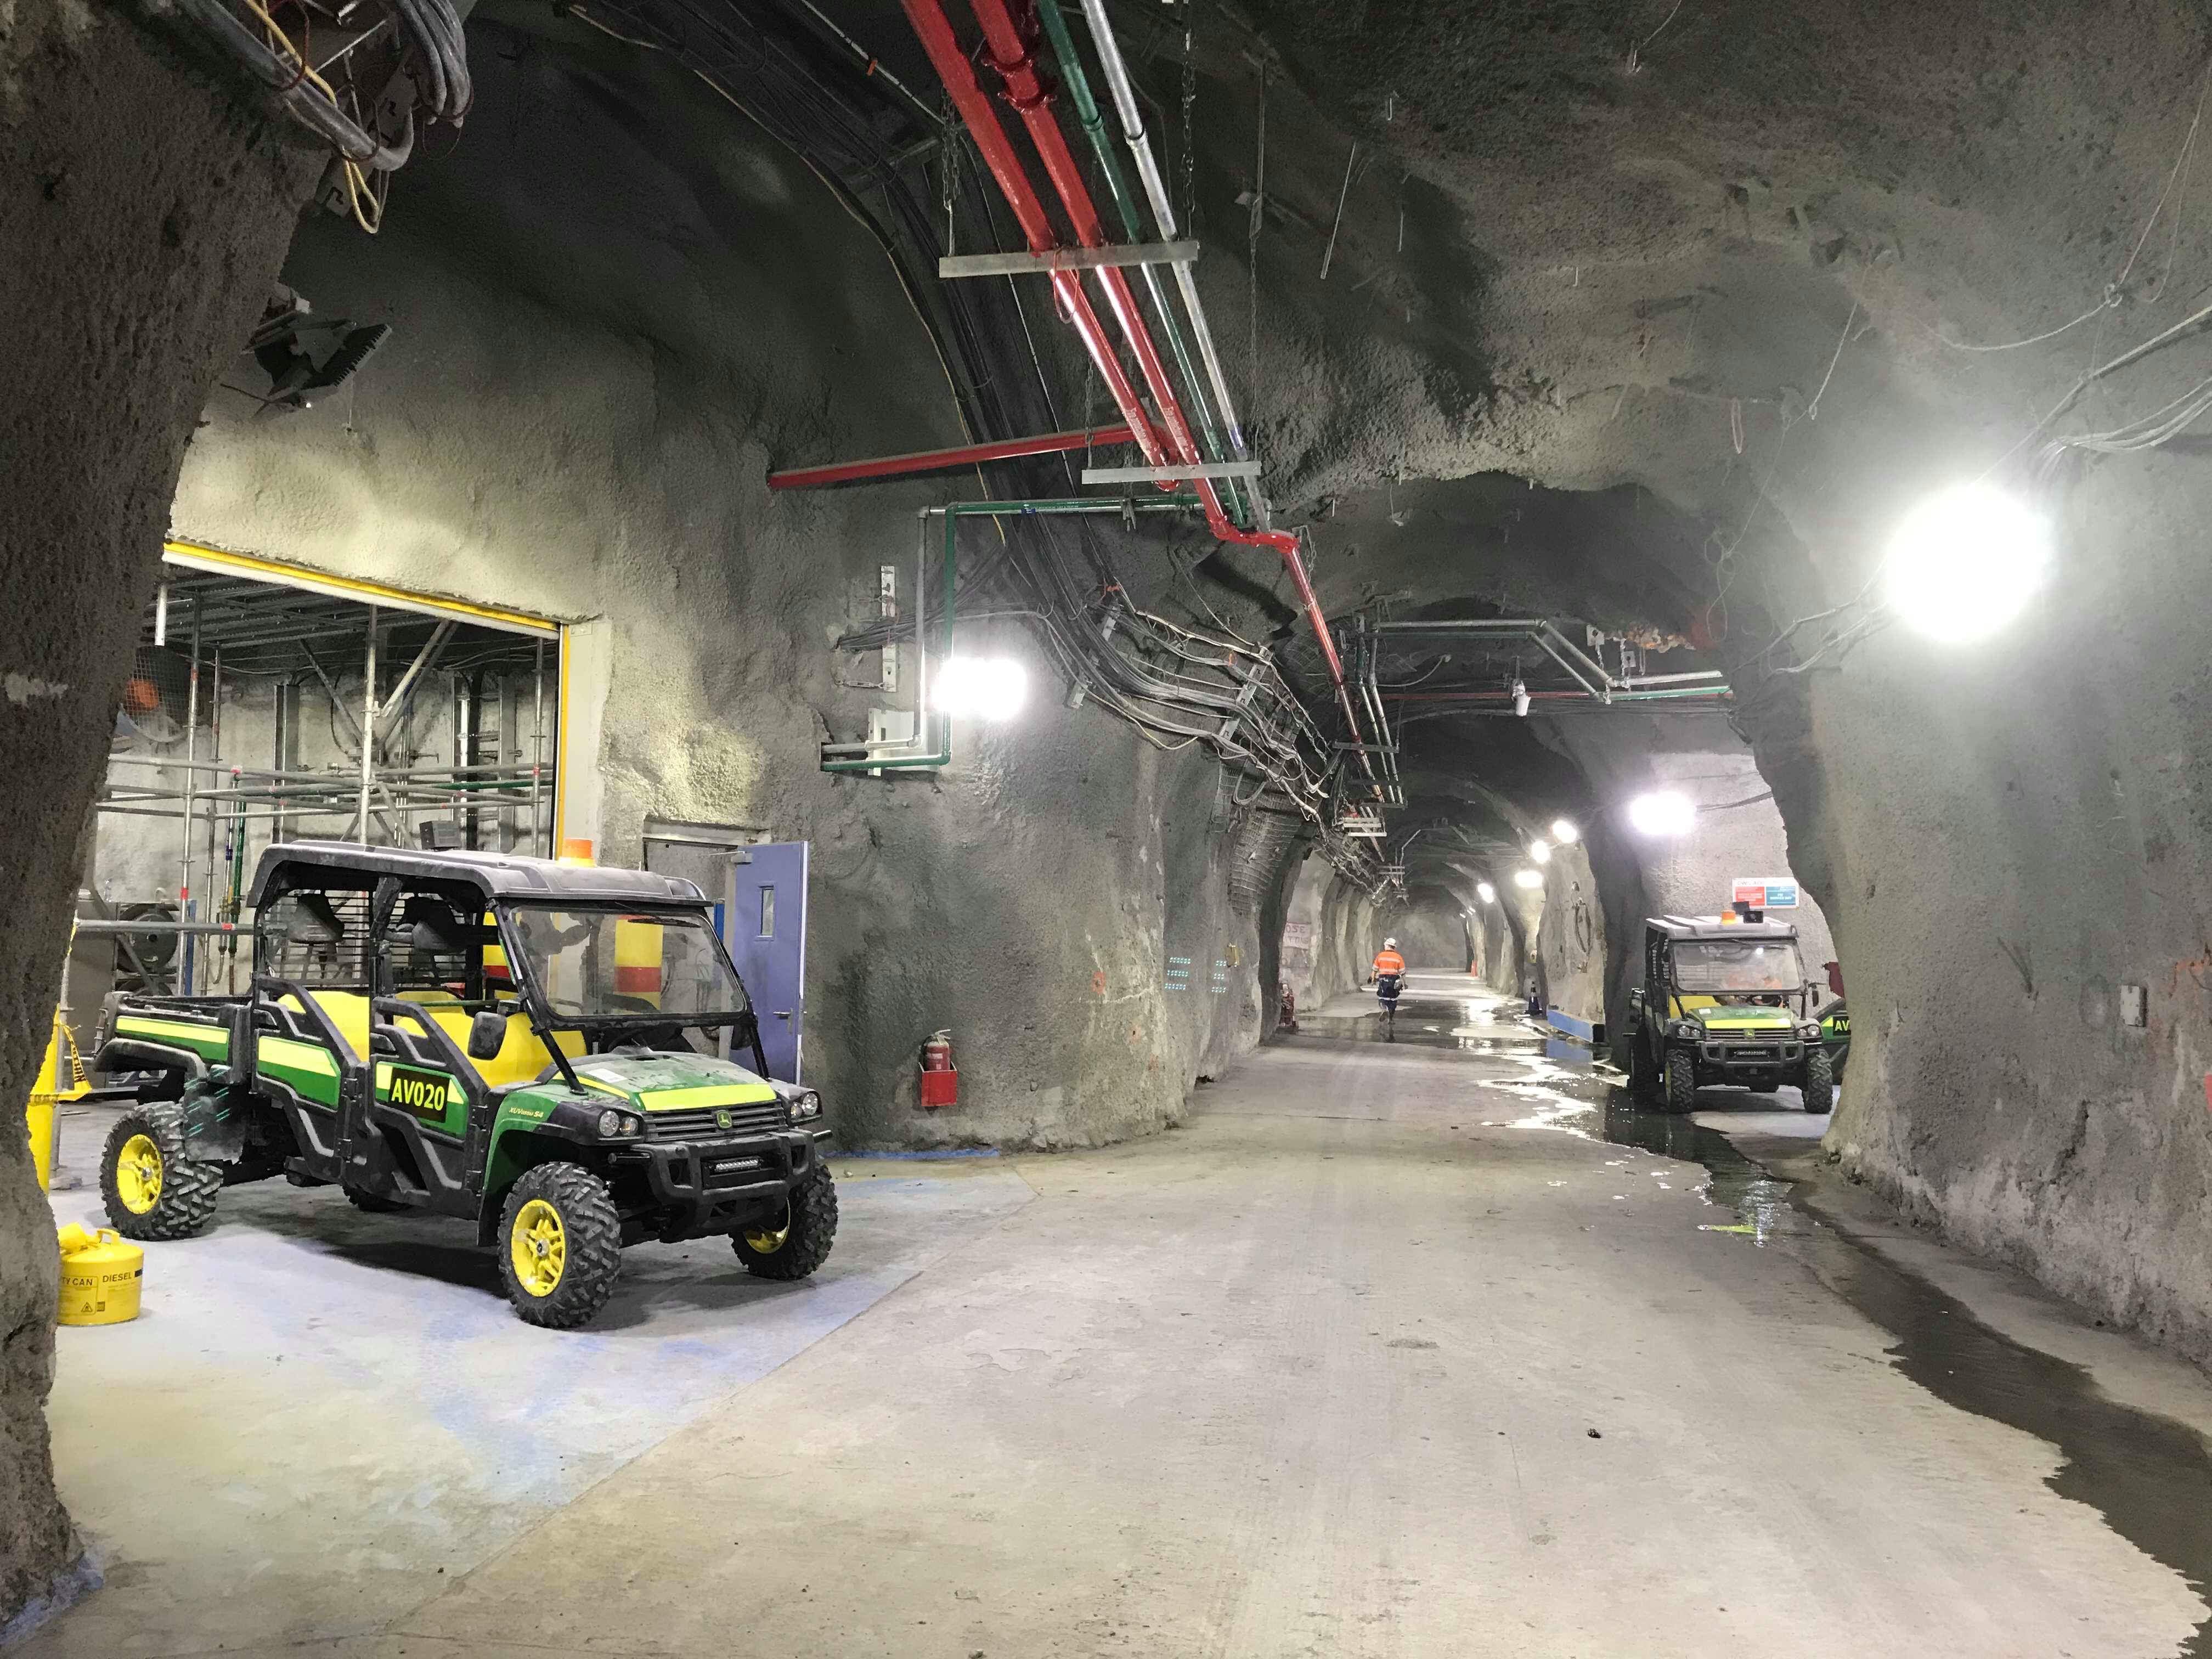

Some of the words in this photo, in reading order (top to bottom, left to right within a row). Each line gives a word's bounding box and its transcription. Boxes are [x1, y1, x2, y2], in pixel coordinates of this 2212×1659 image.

[391, 1078, 445, 1111] AV020
[72, 1278, 93, 1286] CAN
[103, 1272, 132, 1283] DIESEL
